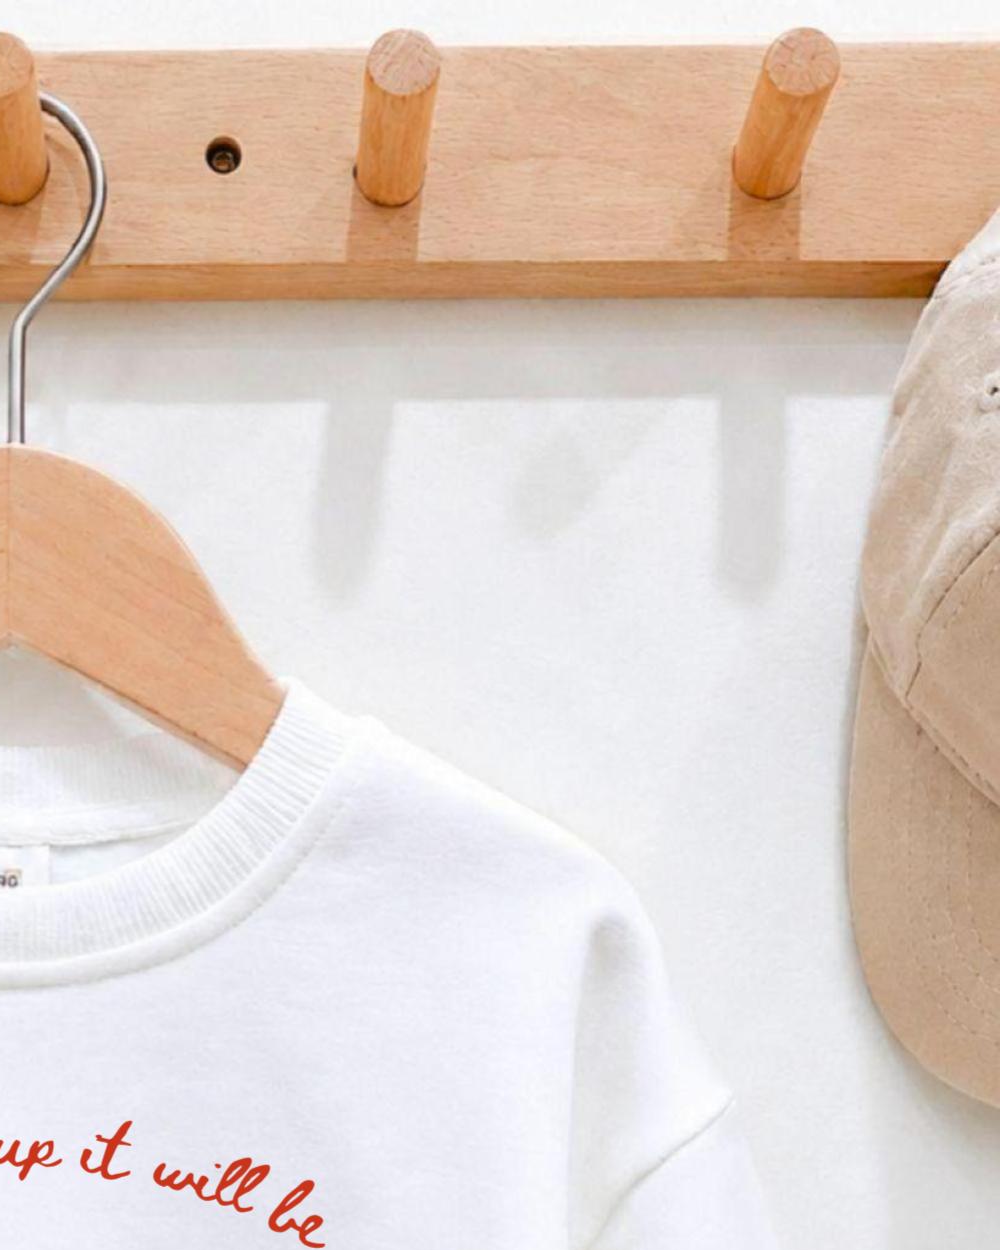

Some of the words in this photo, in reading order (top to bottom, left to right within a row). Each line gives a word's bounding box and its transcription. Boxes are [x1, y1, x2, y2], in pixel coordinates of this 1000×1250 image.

[79, 1120, 133, 1180] it
[153, 1157, 268, 1214] will
[267, 1179, 326, 1249] be
